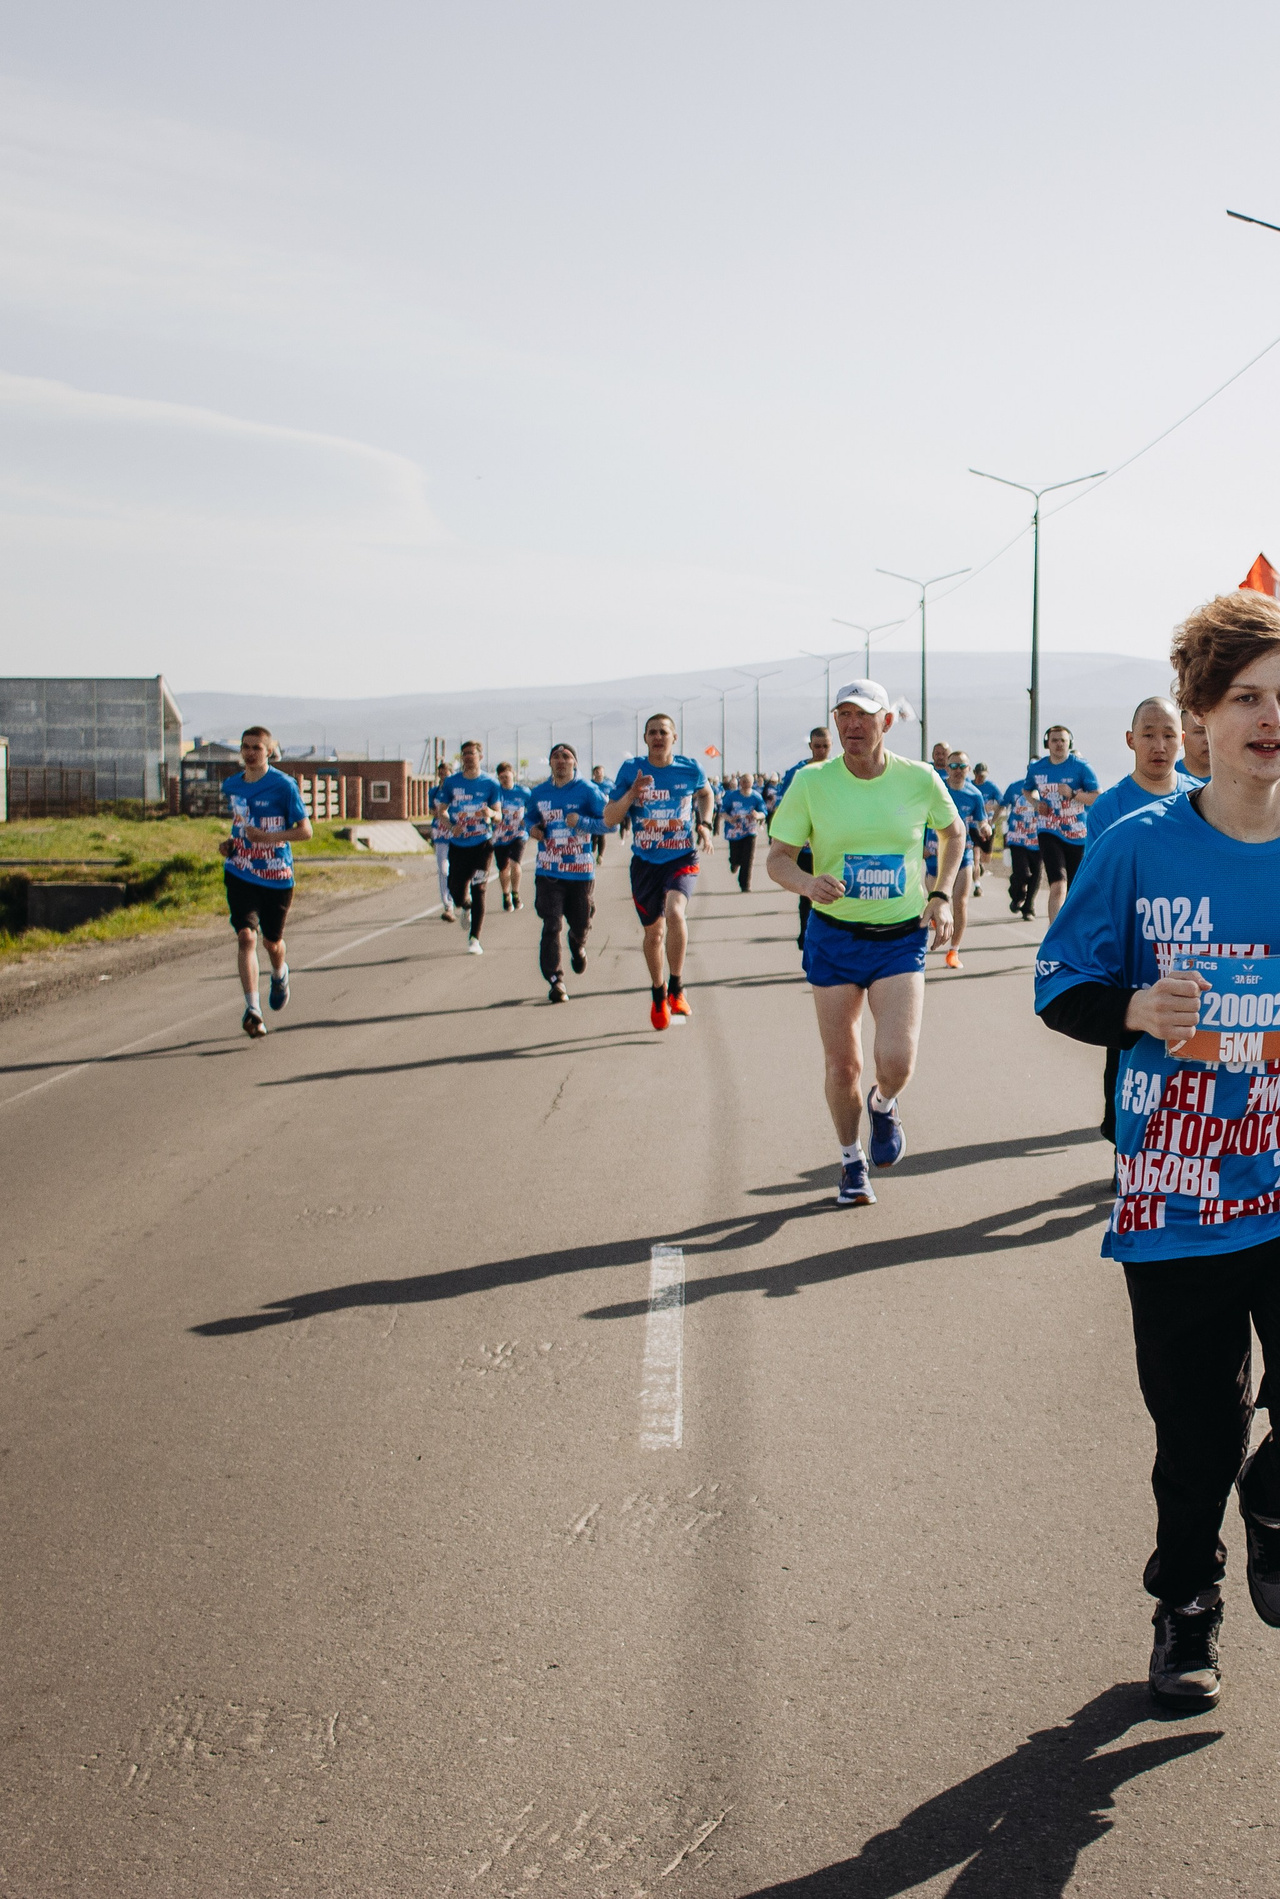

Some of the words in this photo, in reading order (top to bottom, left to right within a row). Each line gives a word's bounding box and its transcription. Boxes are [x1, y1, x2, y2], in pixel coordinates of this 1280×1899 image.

[856, 869, 895, 885] 40001
[1136, 896, 1214, 942] 2024
[1196, 962, 1218, 971] ПСБ
[1219, 1032, 1265, 1063] 5КМ
[1122, 1067, 1217, 1116] #ЗАБЕГ
